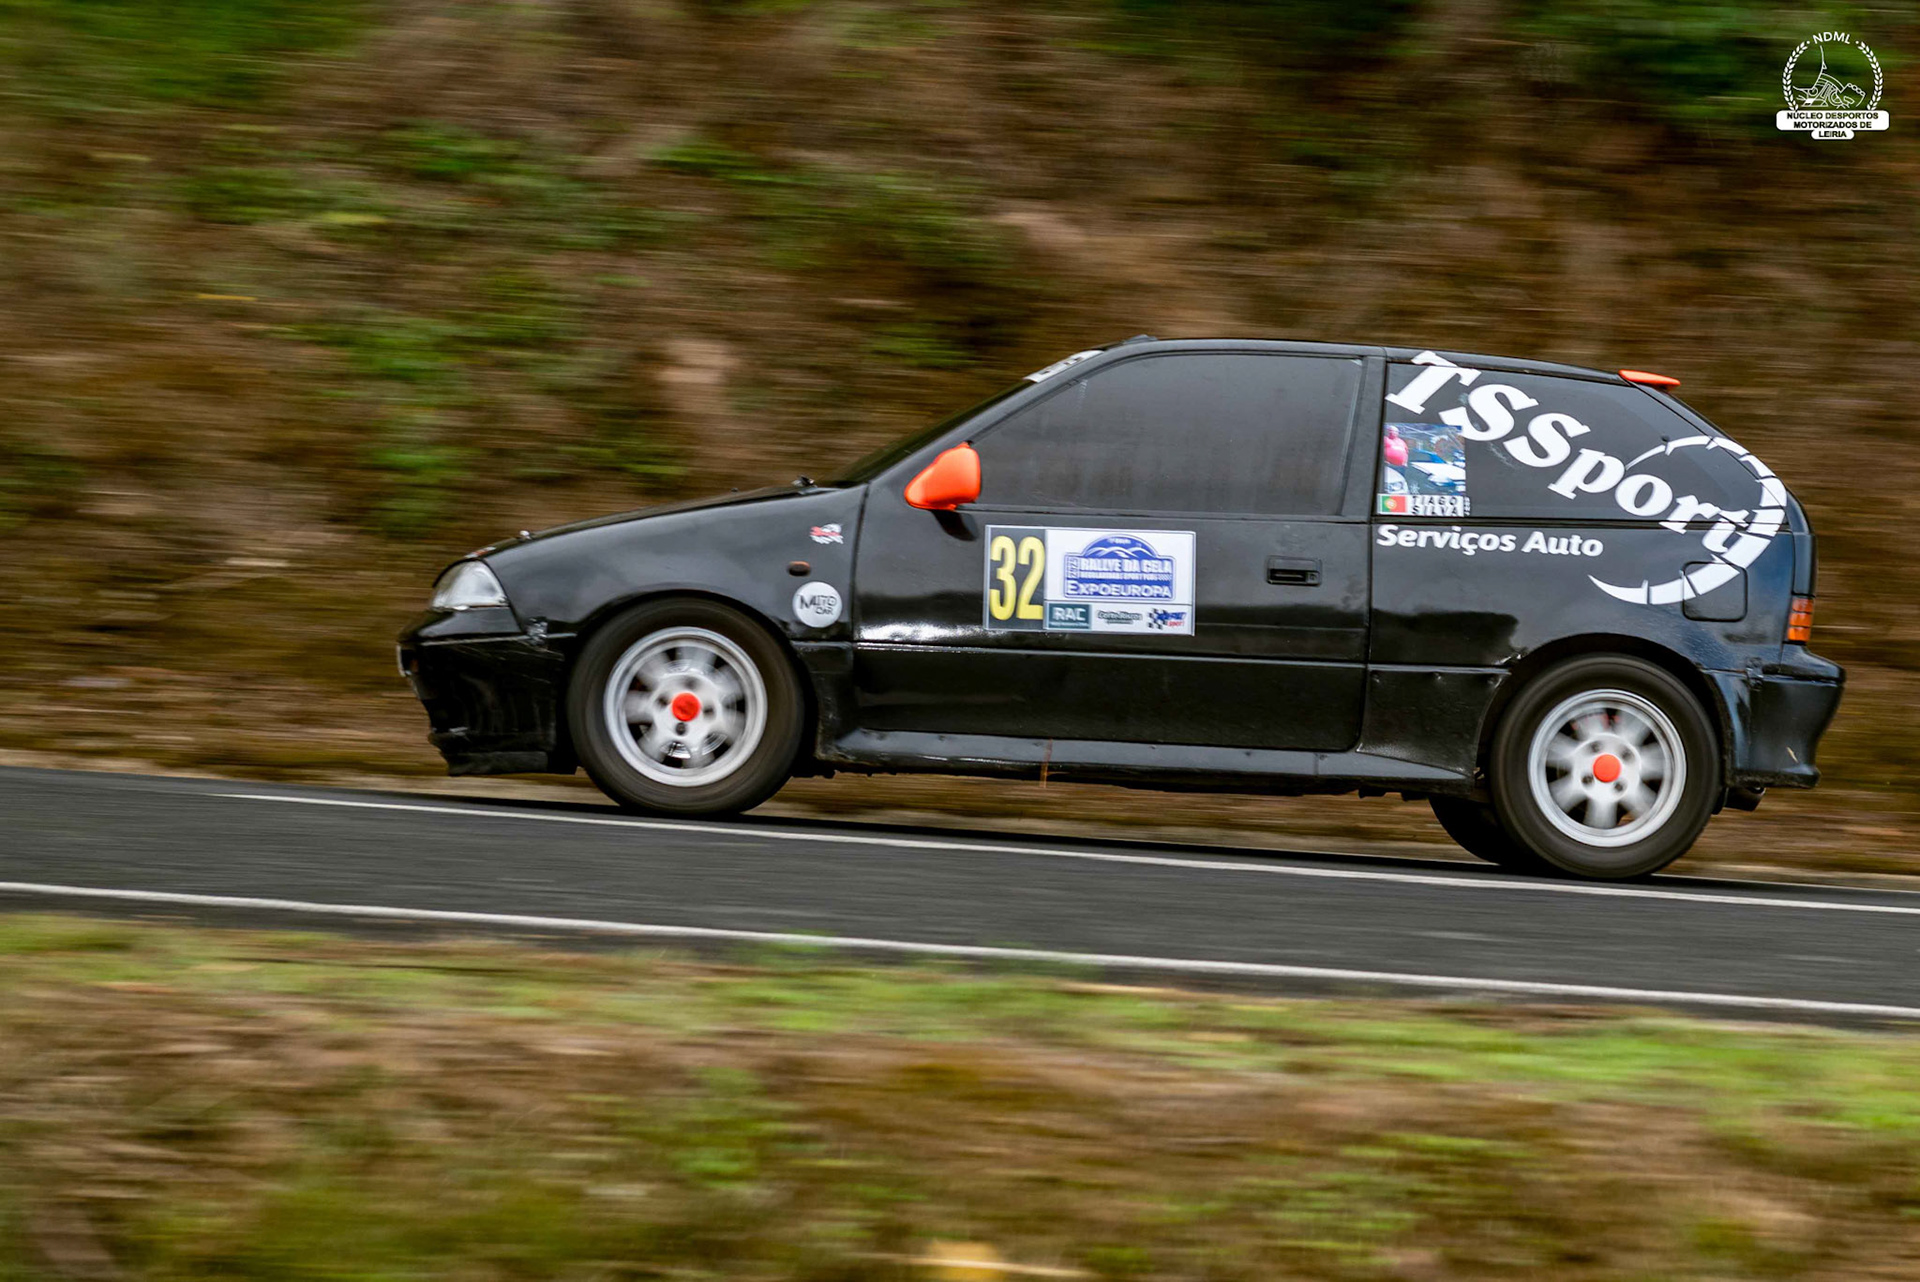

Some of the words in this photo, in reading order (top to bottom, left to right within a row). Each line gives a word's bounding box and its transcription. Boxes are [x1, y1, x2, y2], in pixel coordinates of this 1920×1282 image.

[1412, 495, 1457, 505] TIAGO
[1411, 505, 1459, 516] SILVA
[1376, 524, 1517, 556] Serviços
[1521, 530, 1604, 557] Auto
[1080, 558, 1122, 572] RALLYE
[1122, 559, 1141, 573] DA
[1142, 560, 1173, 574] CELA
[989, 535, 1045, 621] 32
[1051, 607, 1087, 621] RAC
